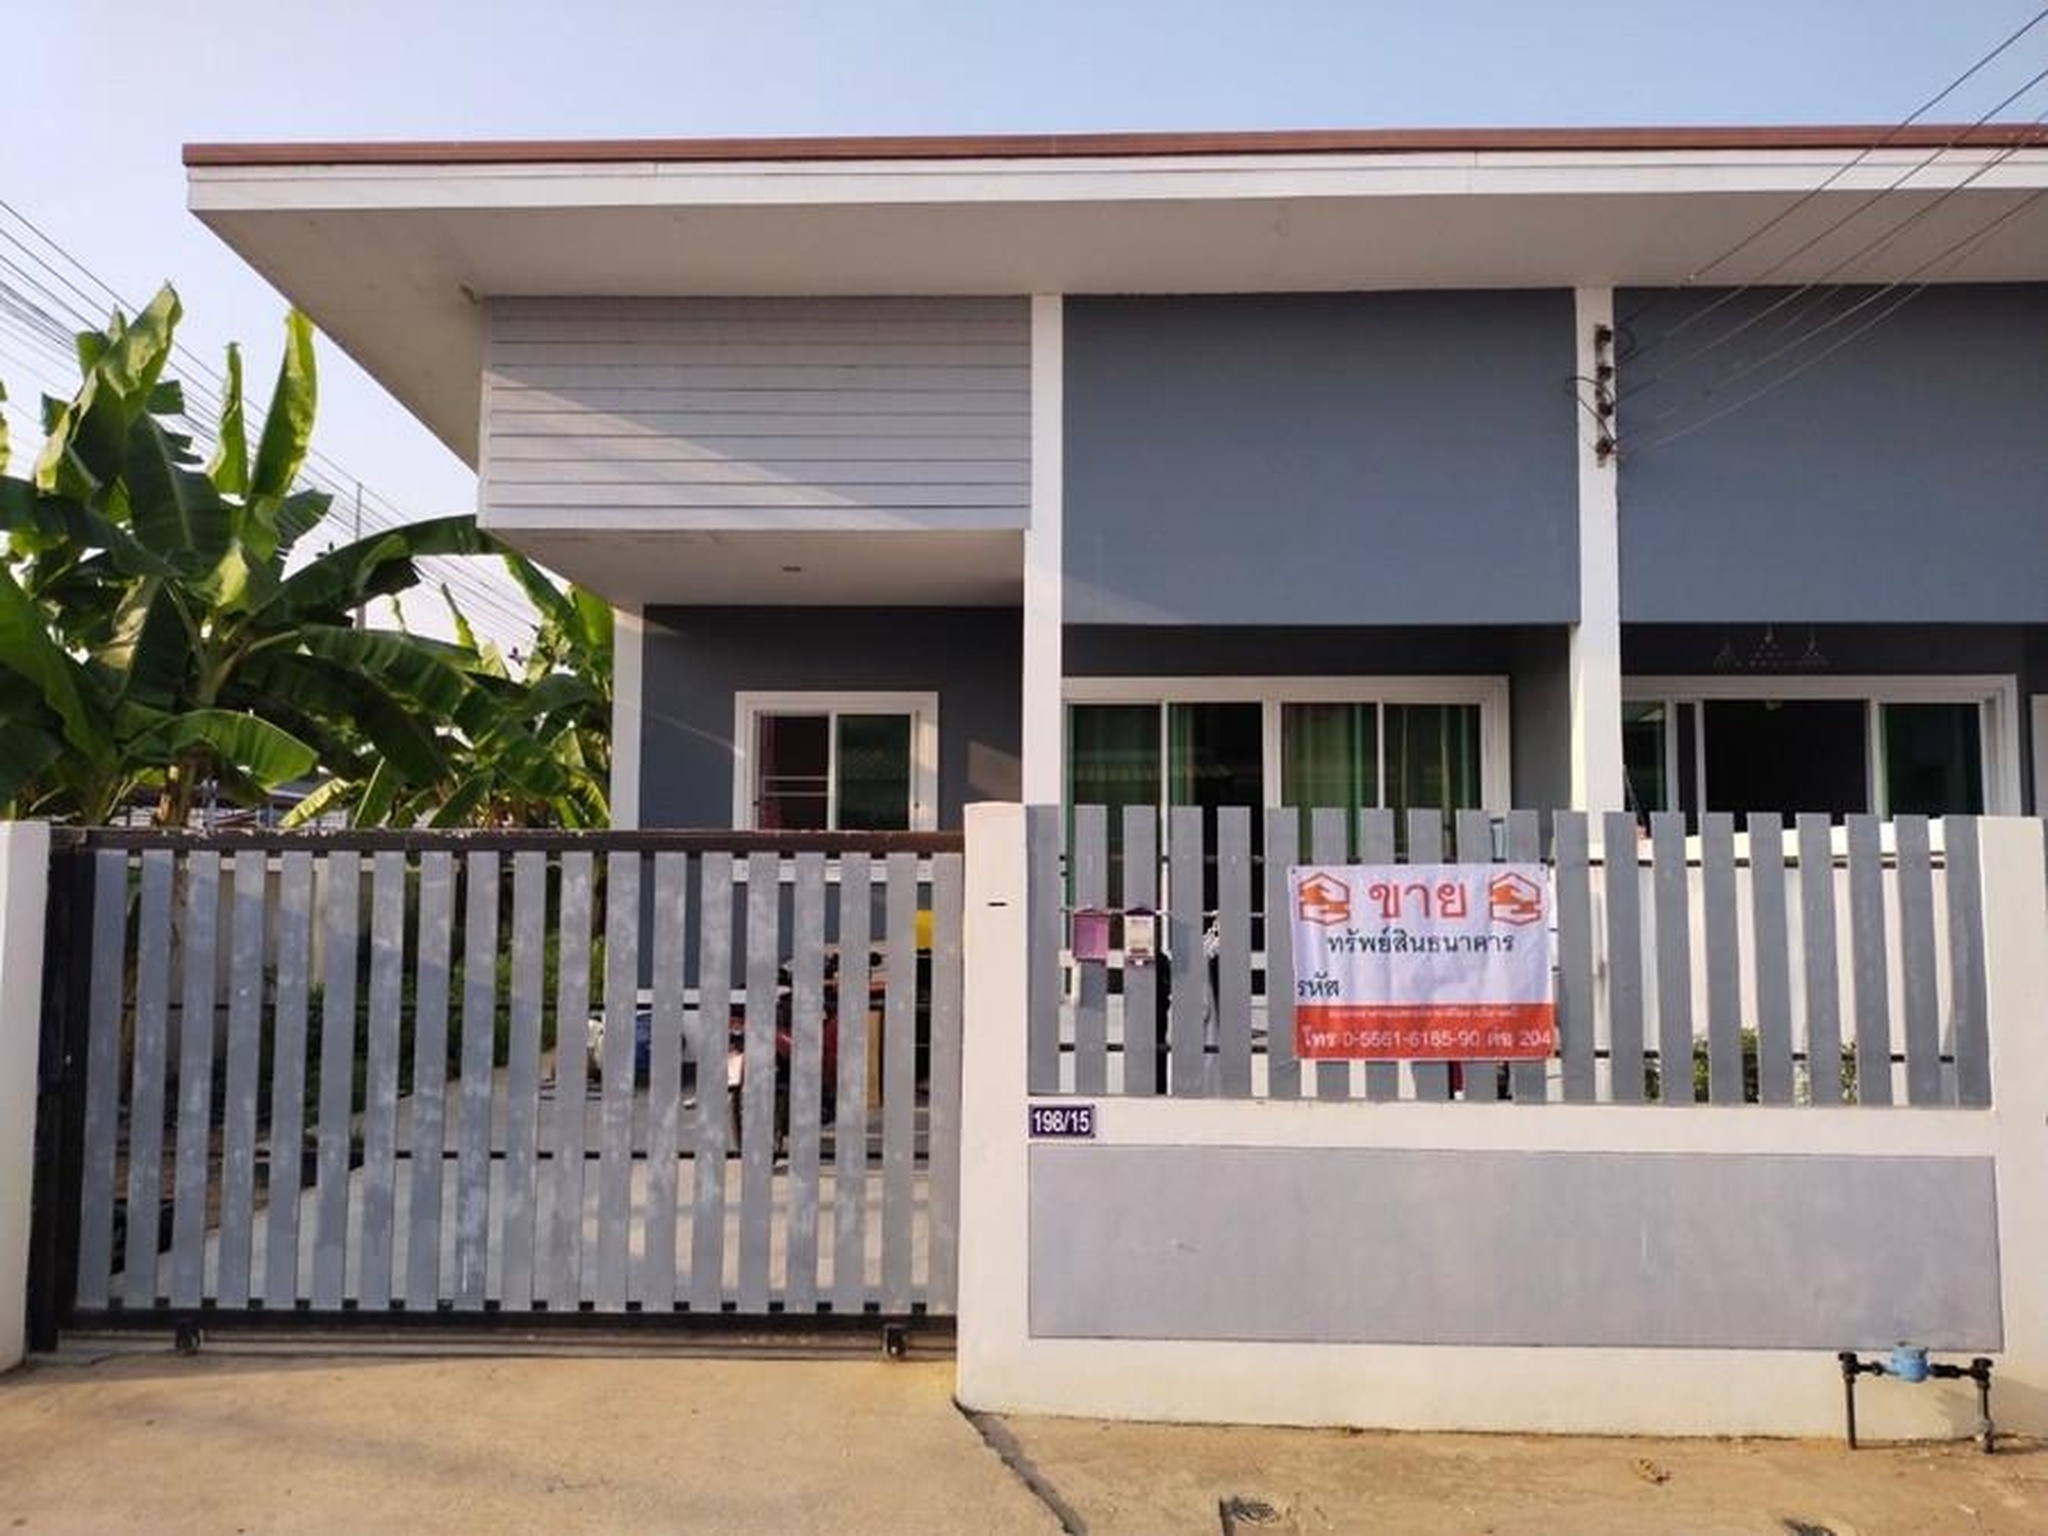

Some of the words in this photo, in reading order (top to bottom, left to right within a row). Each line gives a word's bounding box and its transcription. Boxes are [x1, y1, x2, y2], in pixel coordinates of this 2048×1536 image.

[1369, 881, 1467, 918] ขาย
[1327, 925, 1515, 953] ทรัพย์สินธนาคาร
[1297, 971, 1340, 997] รหัส
[1519, 1029, 1551, 1047] 204
[1033, 1110, 1089, 1131] 198/15
